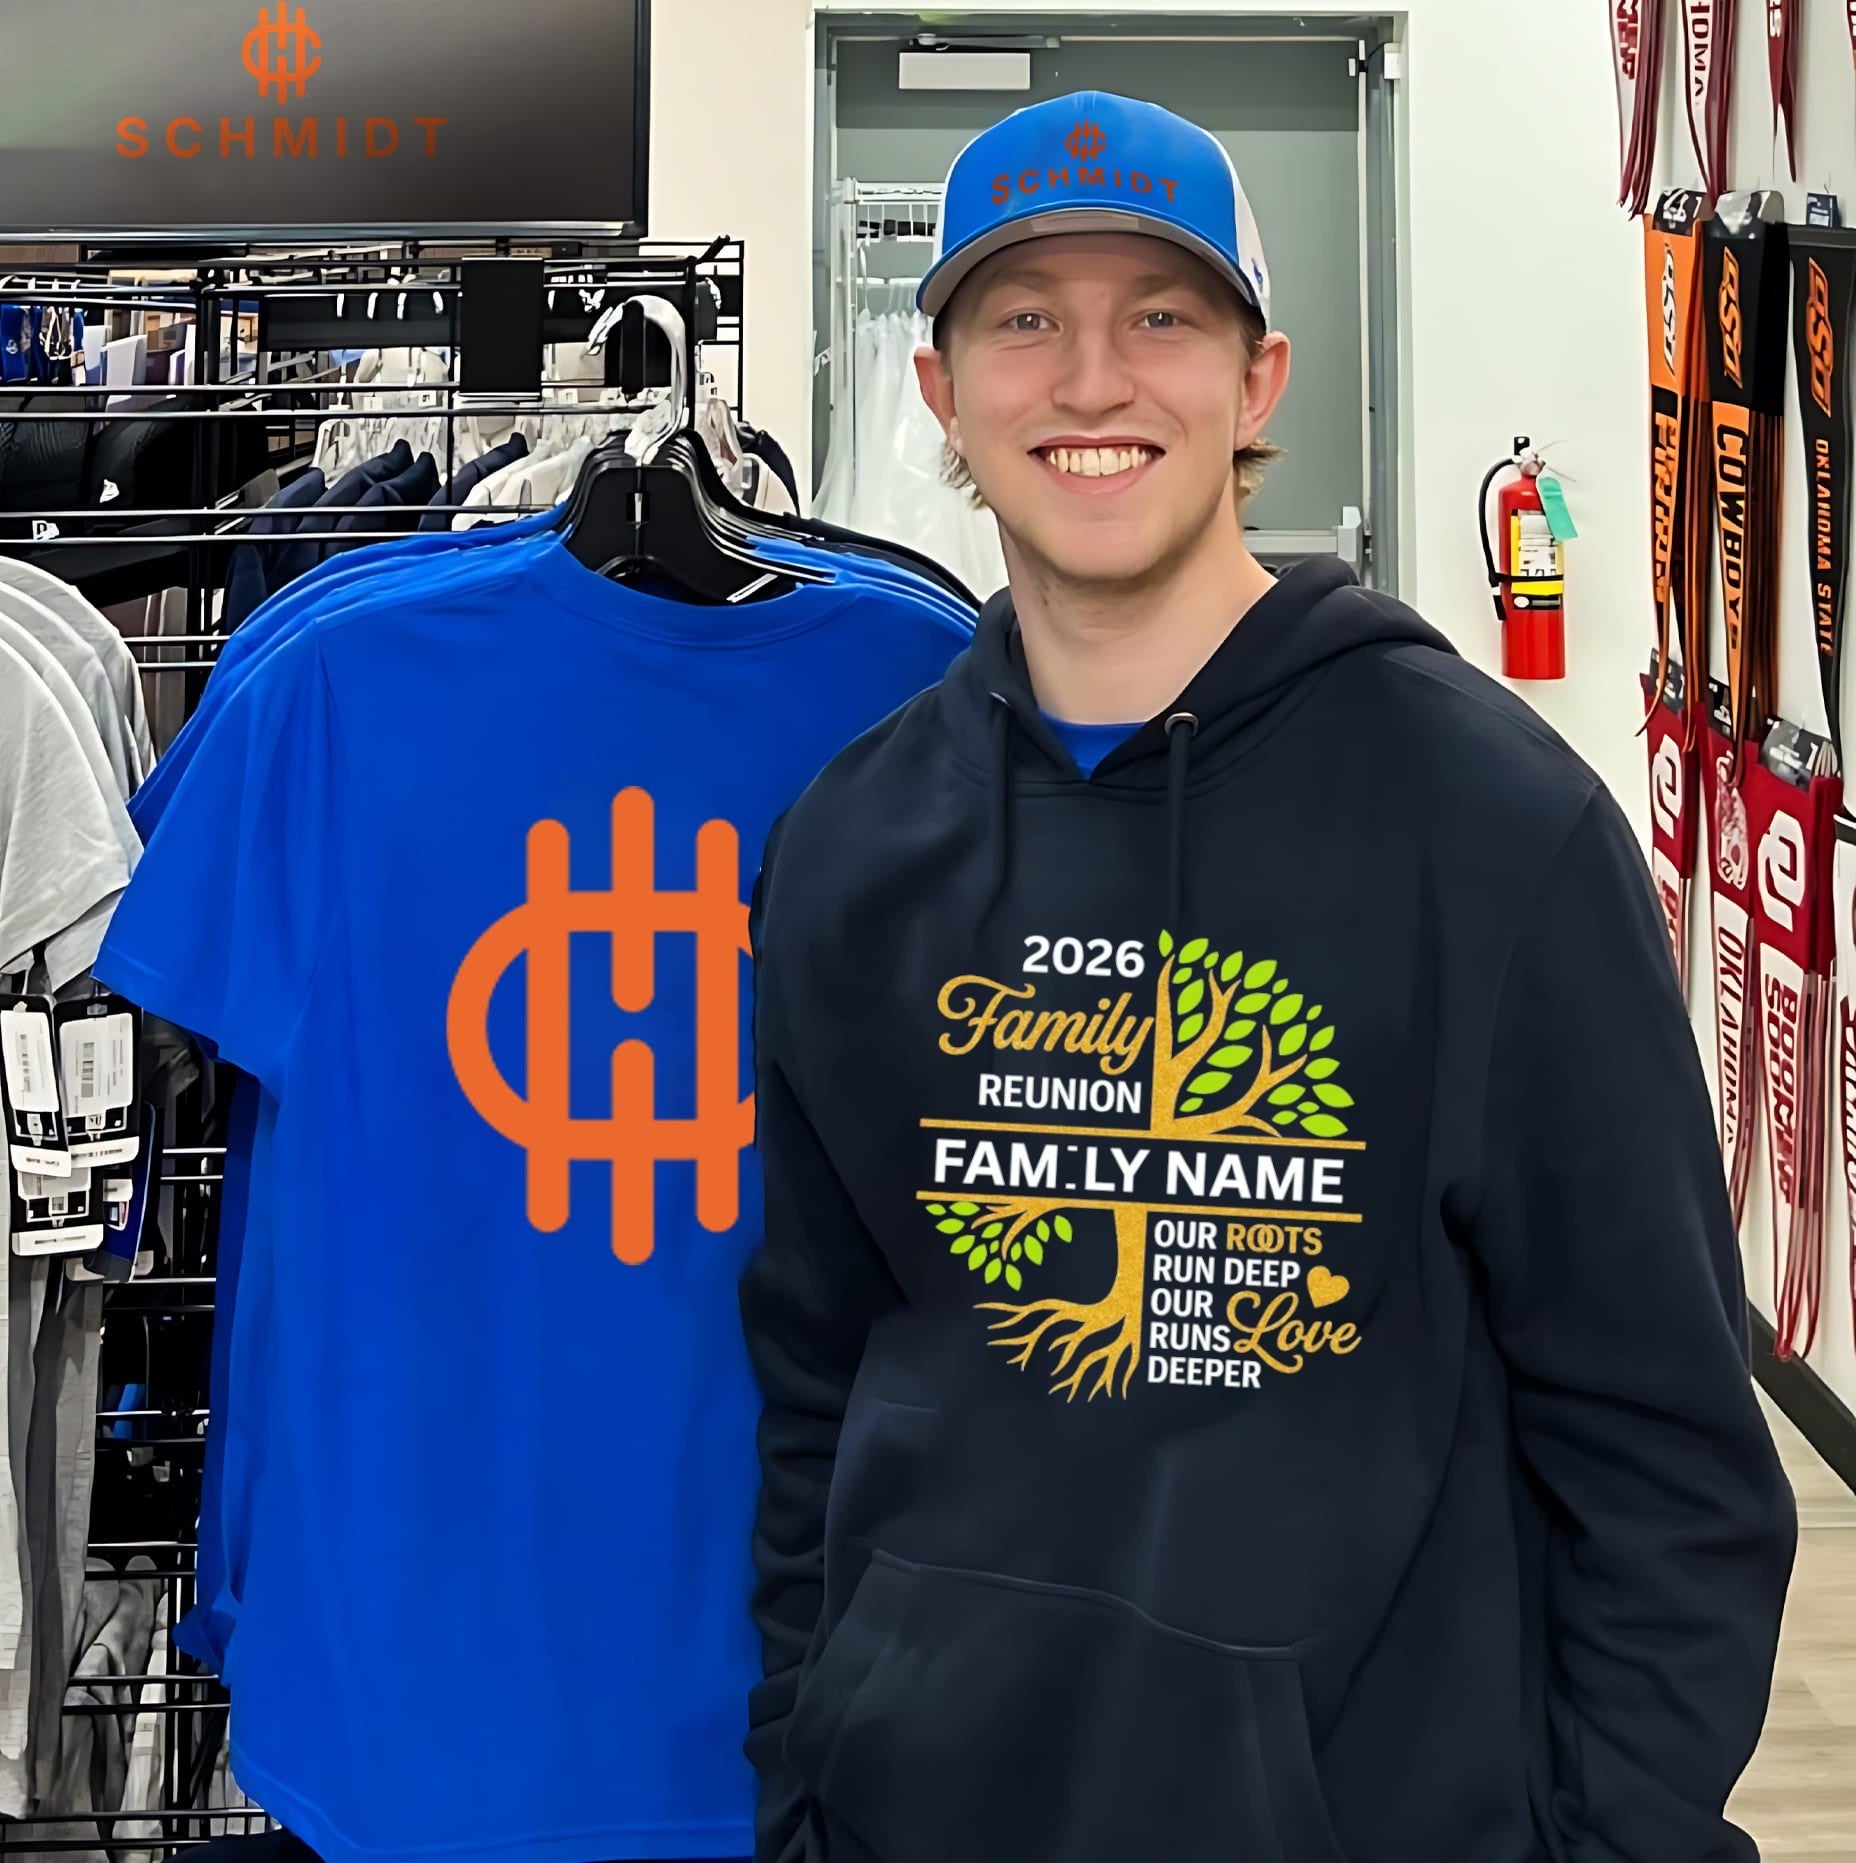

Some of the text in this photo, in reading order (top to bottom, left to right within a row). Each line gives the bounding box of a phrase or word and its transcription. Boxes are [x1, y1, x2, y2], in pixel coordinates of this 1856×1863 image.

[116, 116, 447, 158] SCHMIDT
[992, 167, 1179, 204] SCHMIDT
[1815, 439, 1833, 570] OKLAHOMA
[1022, 935, 1145, 978] 2026
[937, 974, 1154, 1076] Family
[978, 1073, 1142, 1113] REUNION
[1166, 1150, 1344, 1204] NAME
[1154, 1219, 1323, 1255] OUR ROOTS
[1152, 1253, 1301, 1288] RUN DEEP
[1149, 1321, 1231, 1353] RUNS
[1150, 1288, 1362, 1374] OUR Love
[1147, 1355, 1262, 1388] DEEPER
